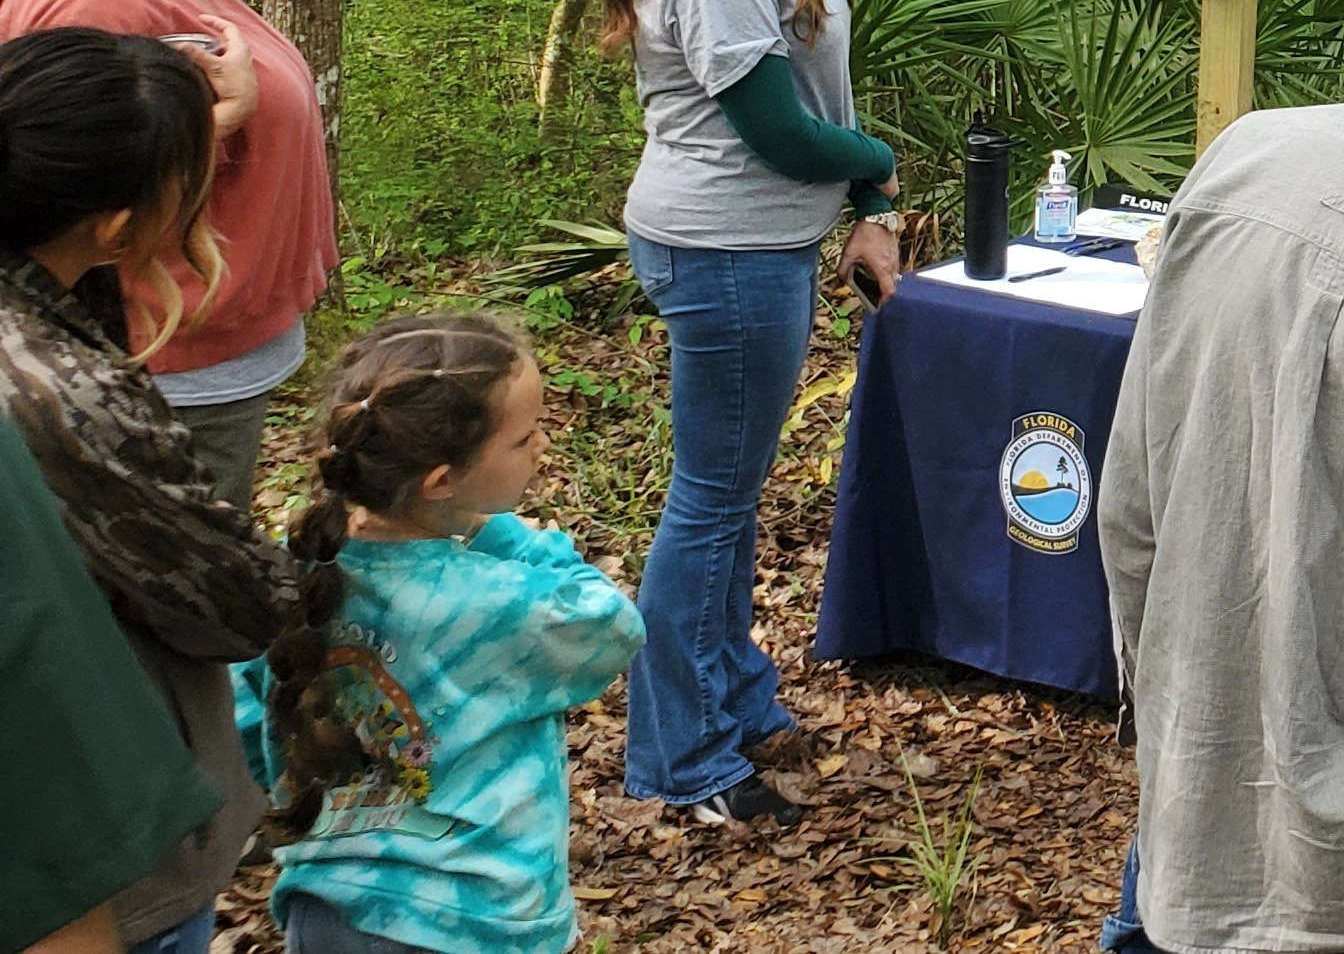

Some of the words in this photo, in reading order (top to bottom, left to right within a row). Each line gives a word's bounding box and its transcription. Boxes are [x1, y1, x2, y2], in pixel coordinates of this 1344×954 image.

[1120, 193, 1168, 214] FLORI
[1023, 415, 1077, 439] FLORIDA
[1006, 436, 1034, 467] FLORIDA
[1036, 432, 1082, 466] DEPARTMENT
[1080, 468, 1088, 482] OF
[1003, 478, 1054, 534] ENVIRONMENTAL
[1056, 494, 1088, 534] PROTECTION
[1009, 525, 1054, 550] GEOLOGICAL
